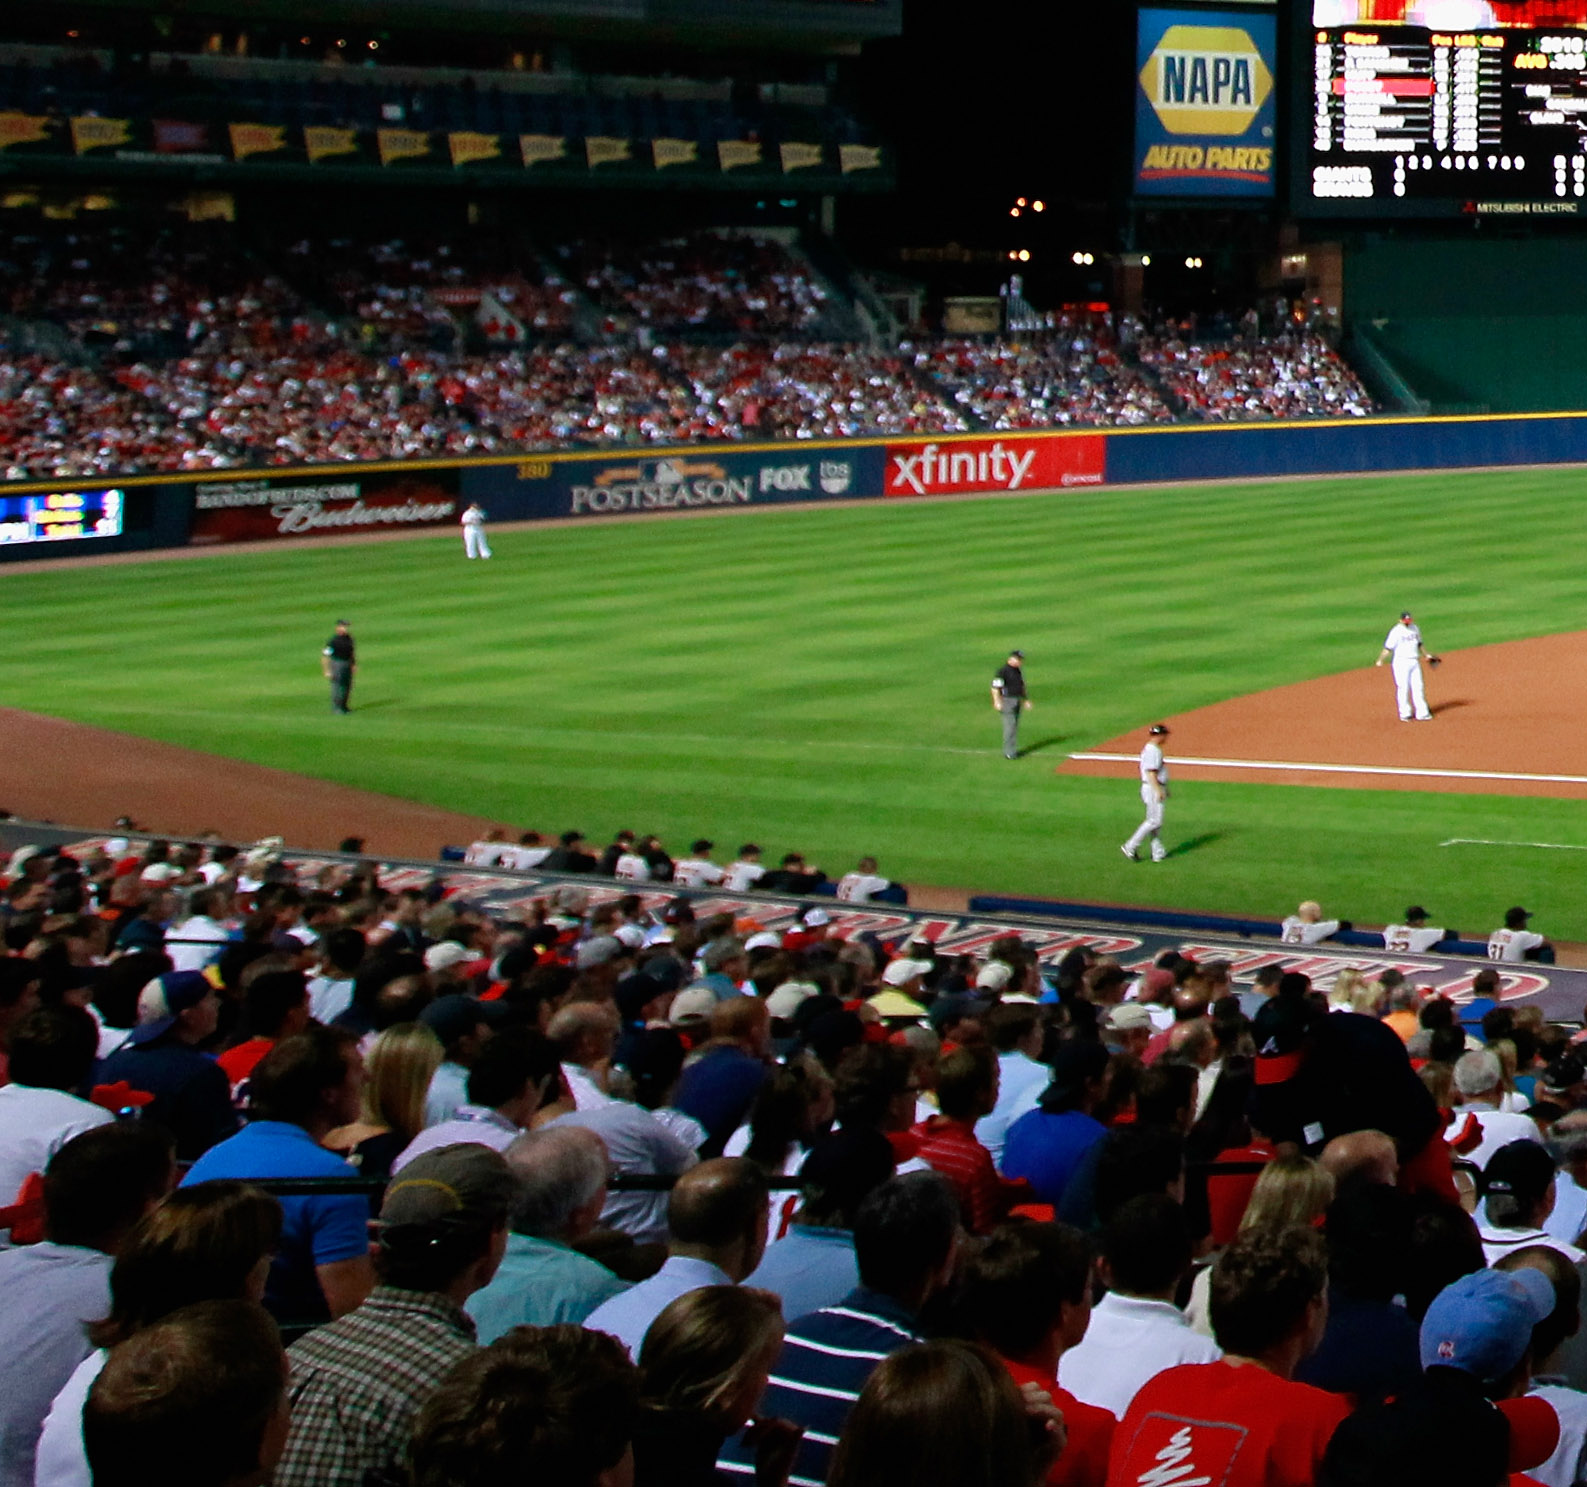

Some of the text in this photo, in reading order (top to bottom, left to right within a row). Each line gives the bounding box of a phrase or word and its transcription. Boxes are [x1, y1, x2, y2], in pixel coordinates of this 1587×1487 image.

[1163, 55, 1252, 106] NAPA
[1142, 145, 1273, 172] AUTO PARTS
[1476, 202, 1578, 213] MITSUBISHI ELECTRIC
[516, 461, 553, 480] 380
[759, 465, 811, 493] FOX
[819, 460, 851, 479] tbs
[892, 442, 1037, 495] xfinity
[1061, 473, 1102, 486] Comcast
[571, 475, 753, 513] POSTSEASON
[271, 499, 455, 534] Budweiser
